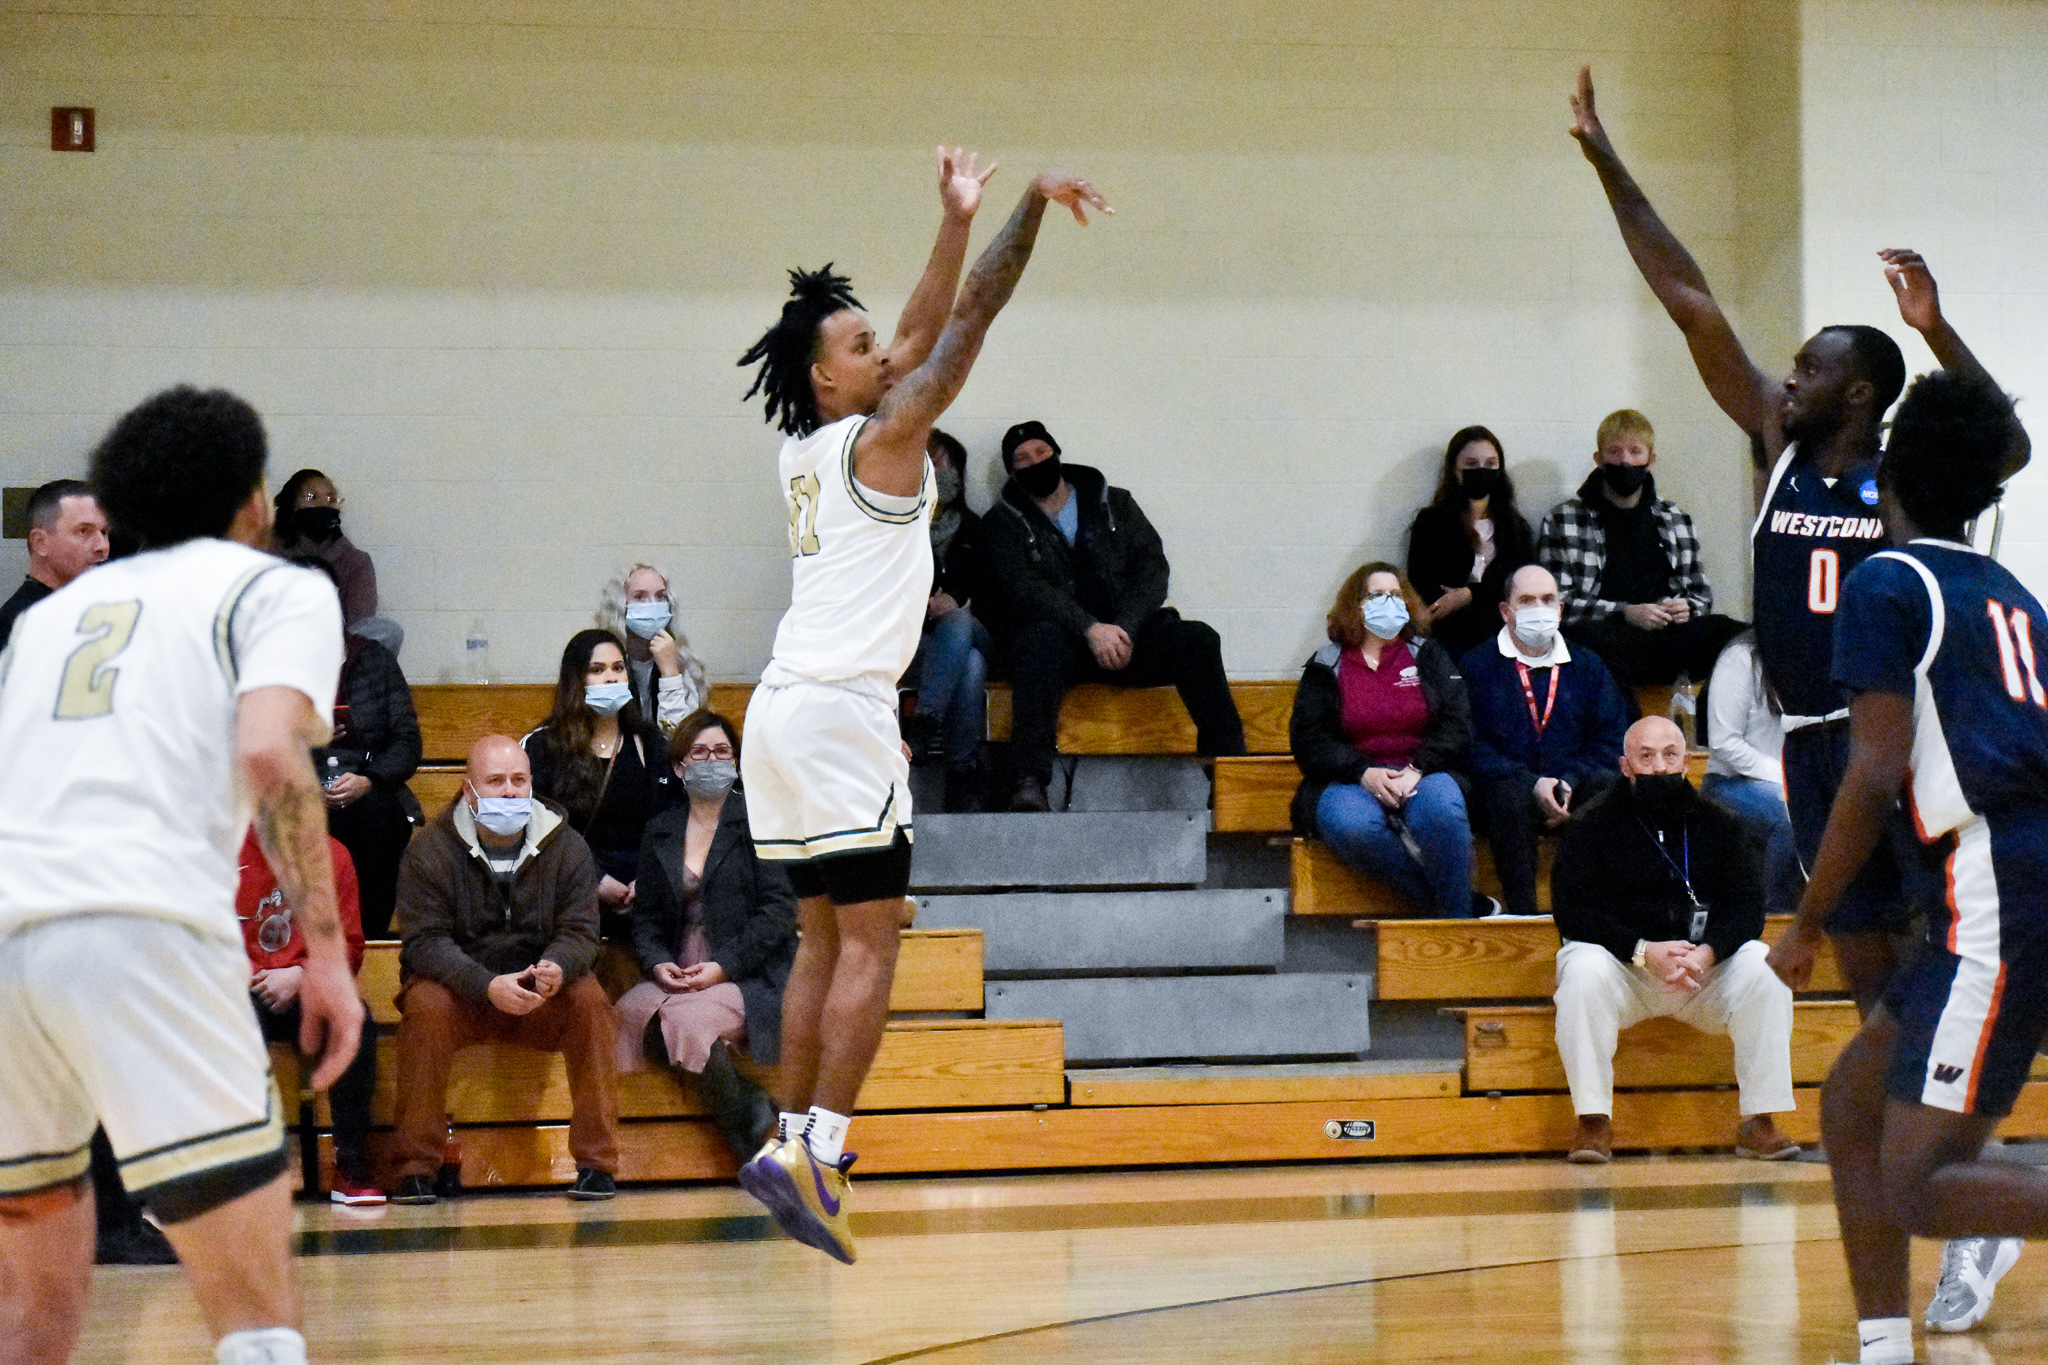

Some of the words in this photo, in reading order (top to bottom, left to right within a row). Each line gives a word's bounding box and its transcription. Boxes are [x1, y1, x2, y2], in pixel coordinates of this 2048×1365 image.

[1861, 490, 1879, 499] NCA
[1808, 548, 1839, 614] 0
[52, 598, 144, 721] 2
[1987, 598, 2048, 709] 11
[1932, 1063, 1965, 1085] W
